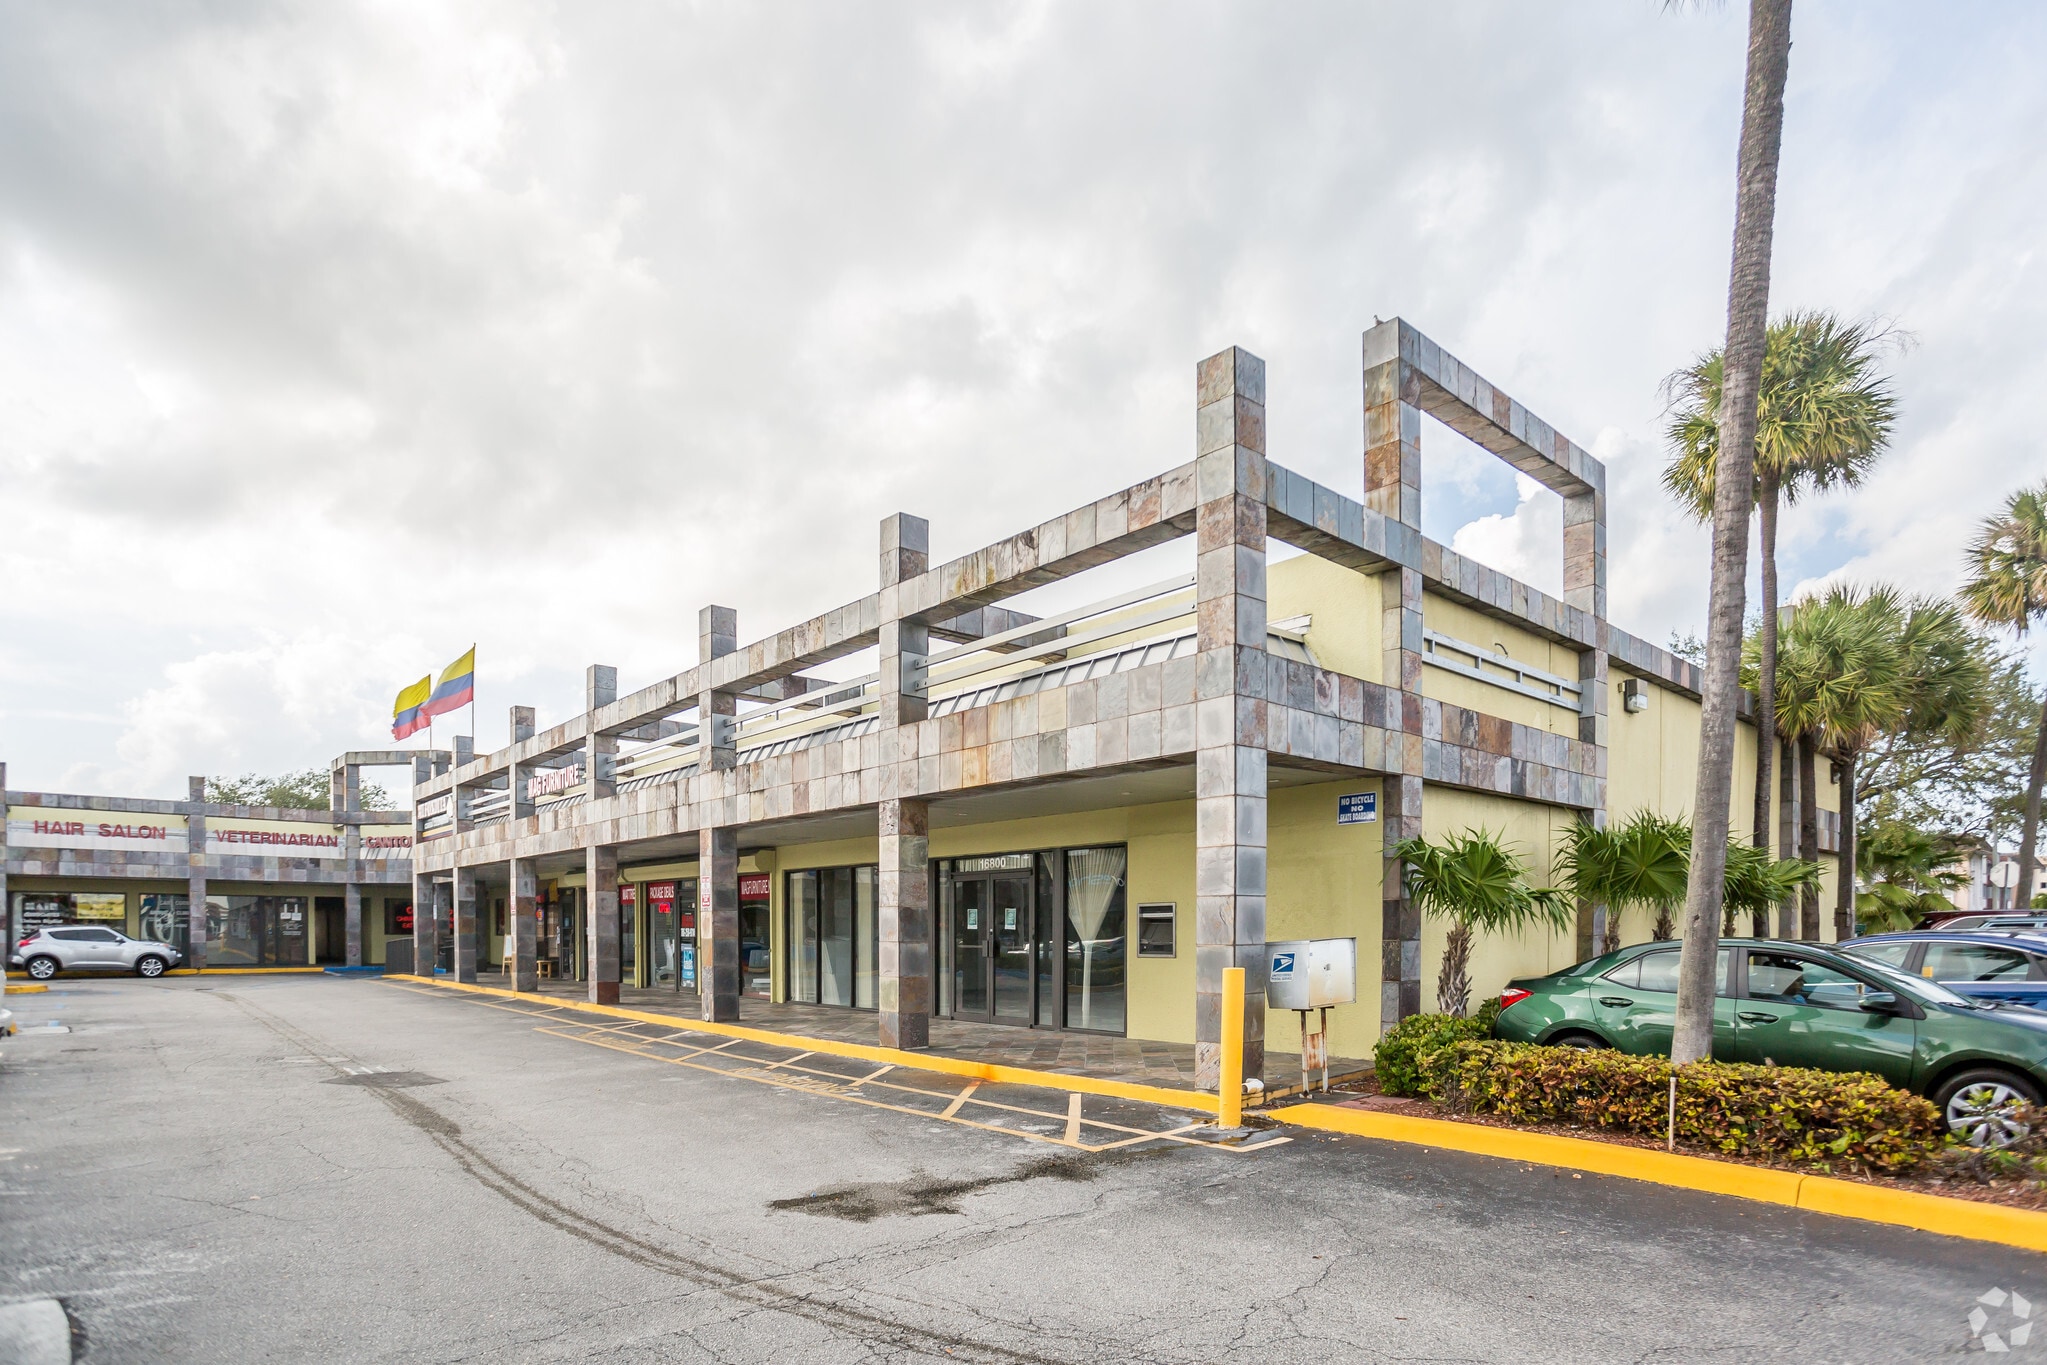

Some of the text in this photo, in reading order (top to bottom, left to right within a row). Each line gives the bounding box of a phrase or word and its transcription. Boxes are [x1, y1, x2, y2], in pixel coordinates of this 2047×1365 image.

[542, 763, 579, 795] FURNITURE
[1351, 795, 1374, 805] BICYCLE
[34, 820, 166, 840] HAIR SALON
[214, 829, 338, 848] VETERINARIAN
[979, 857, 1006, 869] 16800
[664, 886, 674, 898] DEALS
